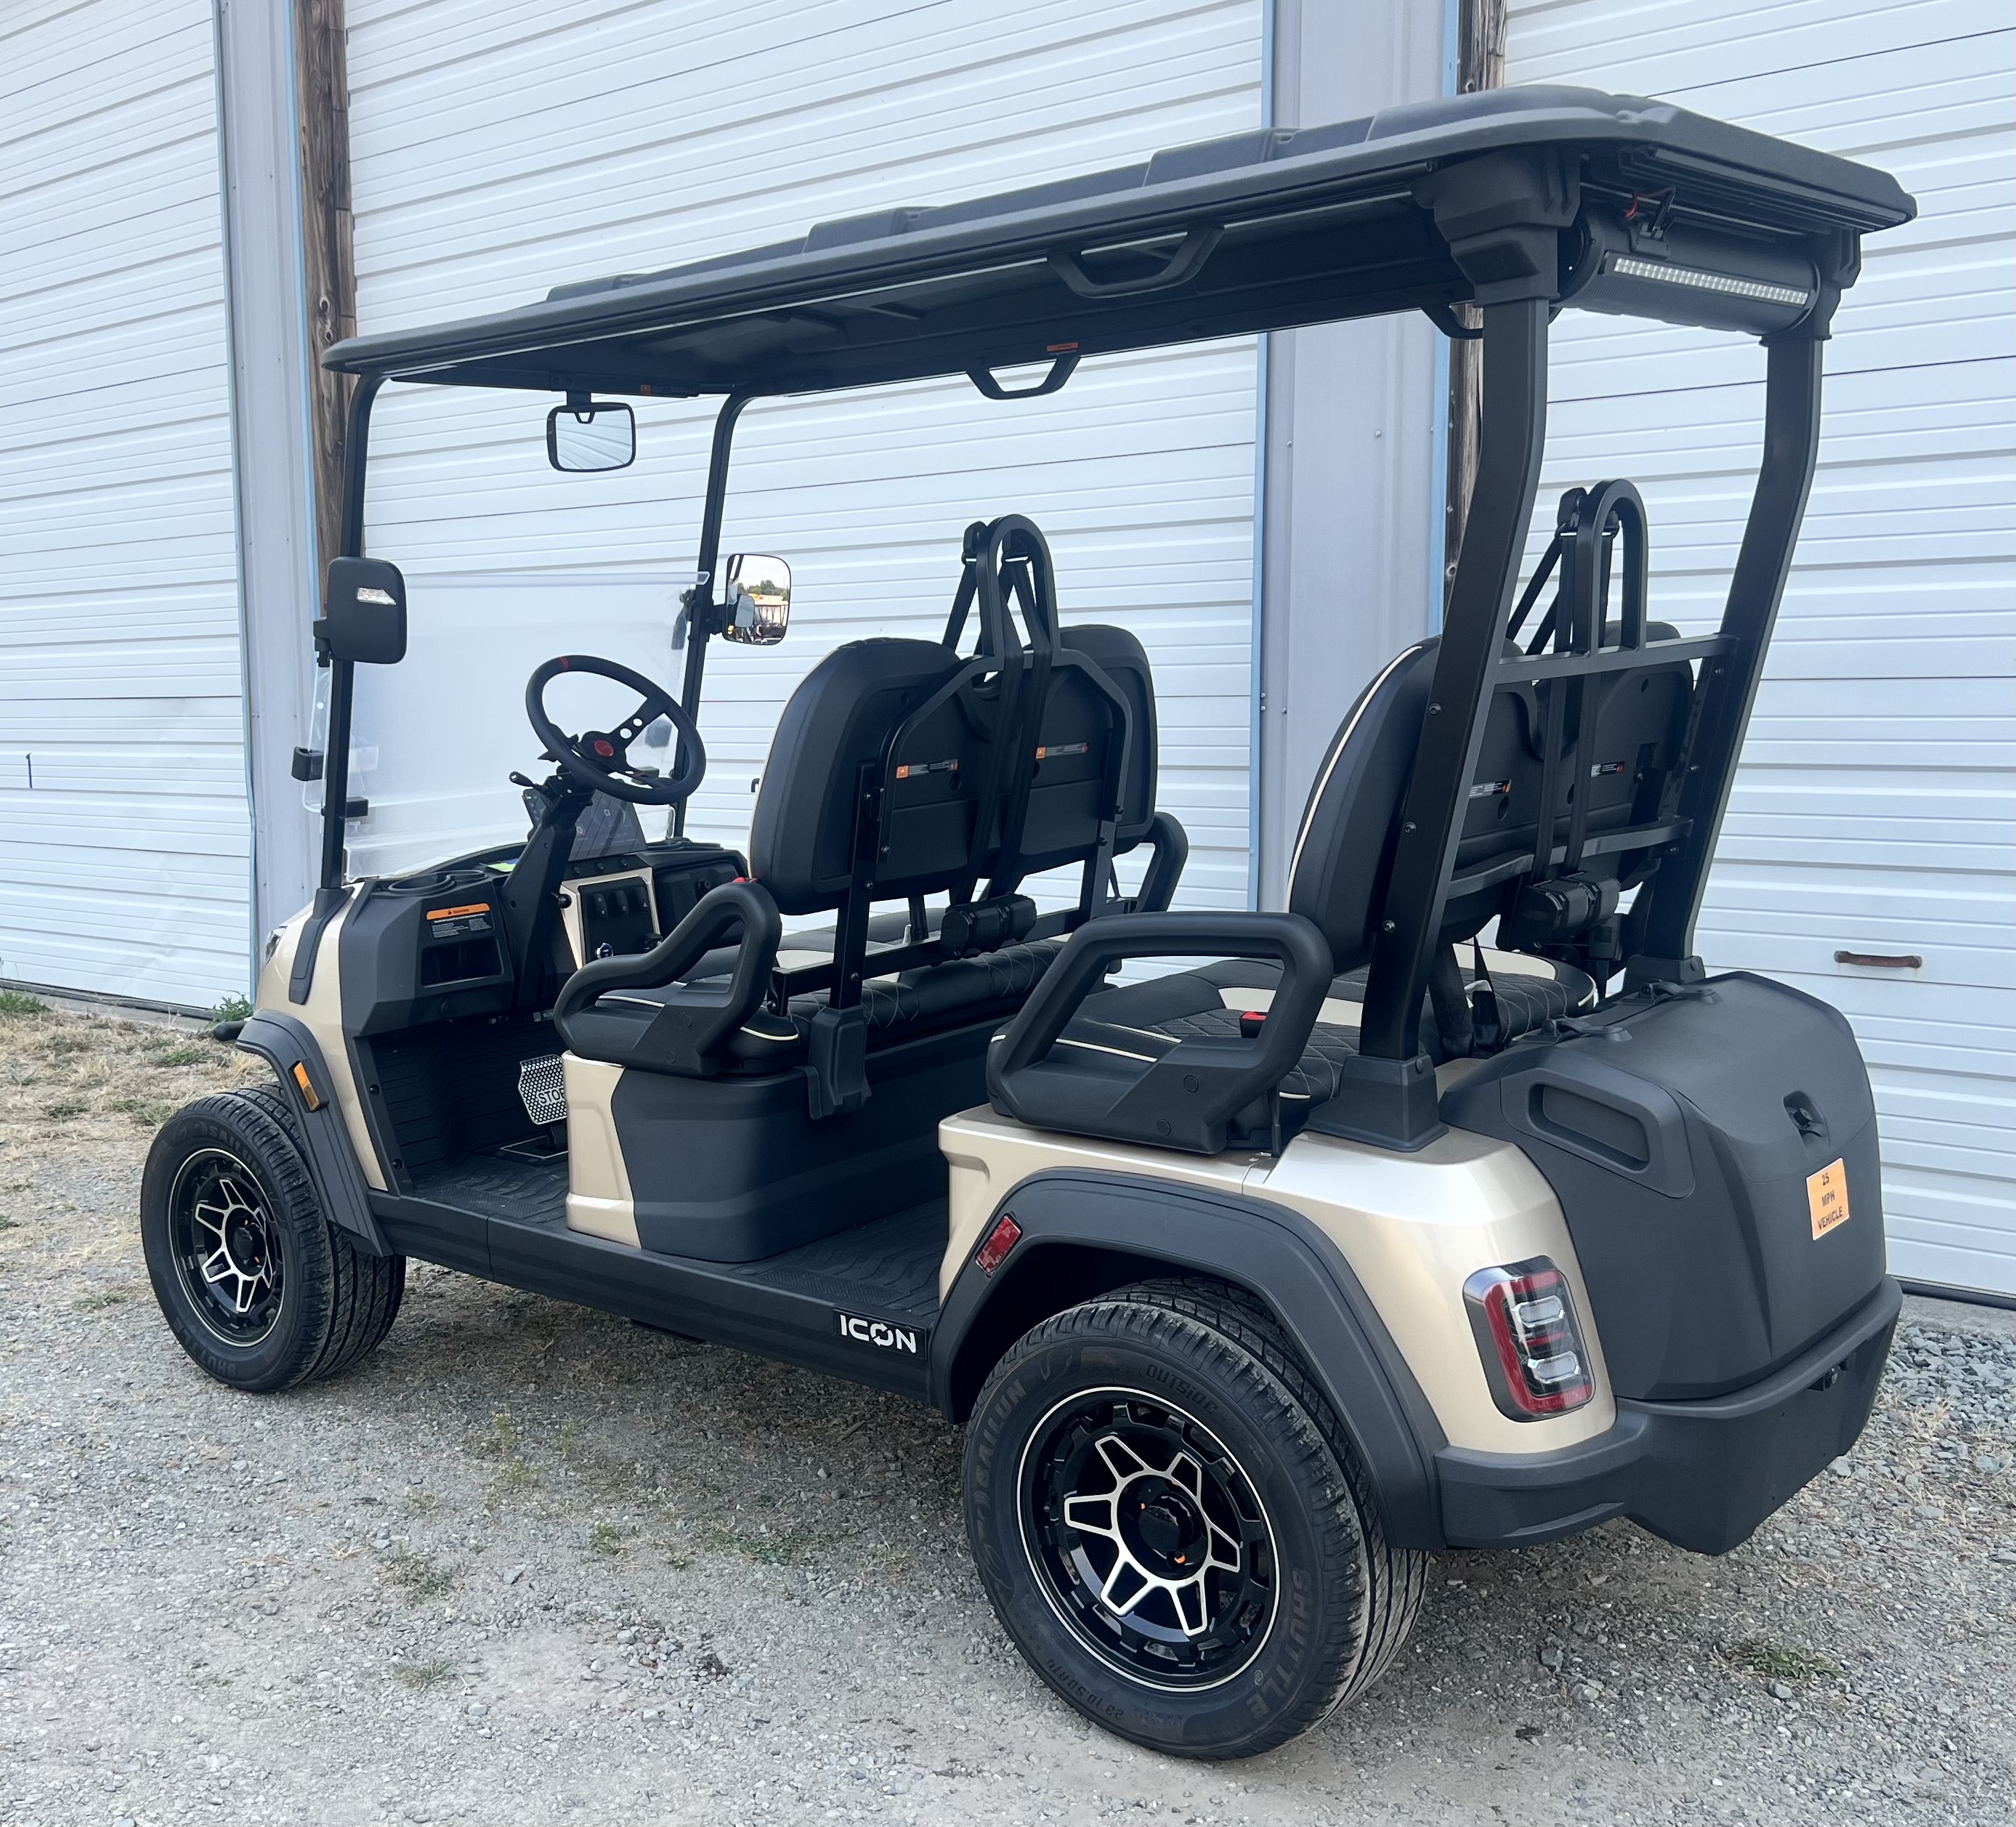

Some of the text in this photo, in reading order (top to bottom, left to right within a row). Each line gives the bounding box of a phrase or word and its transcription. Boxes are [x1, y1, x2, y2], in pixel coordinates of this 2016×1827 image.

[1821, 1172, 1829, 1186] 25
[1821, 1190, 1835, 1207] MPH
[1818, 1206, 1843, 1230] VEHICLE
[840, 1314, 917, 1353] ICON
[975, 1378, 1027, 1488] SAILUN
[1246, 1567, 1313, 1720] SHUTTLE
